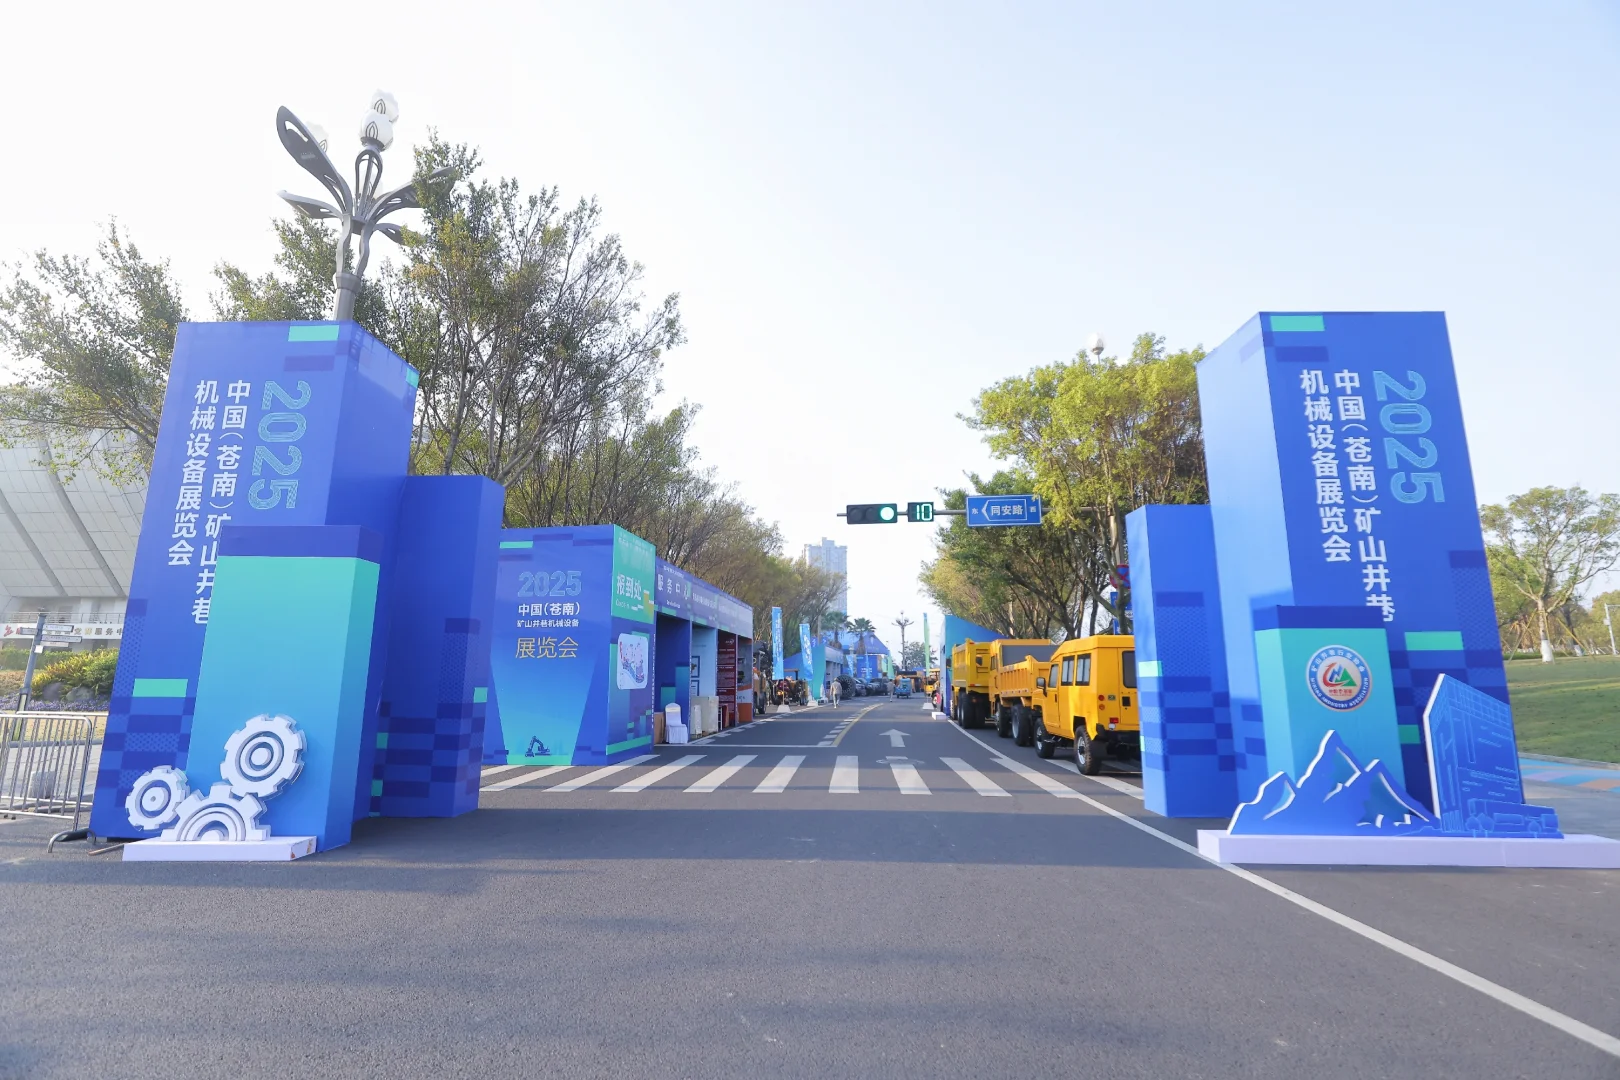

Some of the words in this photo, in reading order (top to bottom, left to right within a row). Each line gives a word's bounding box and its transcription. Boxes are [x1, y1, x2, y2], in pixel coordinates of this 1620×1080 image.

[248, 380, 311, 509] 2025
[1373, 370, 1445, 504] 2025
[168, 380, 219, 566] 机械设备展览会
[1300, 369, 1351, 562] 机械设备展览会
[917, 503, 932, 521] 10
[991, 505, 1023, 515] 同安路
[518, 571, 582, 597] 2025
[617, 574, 641, 600] 报到处
[518, 602, 580, 616] 中国（苍南）
[516, 619, 579, 628] 矿山井巷机械设备
[516, 636, 579, 658] 展览会
